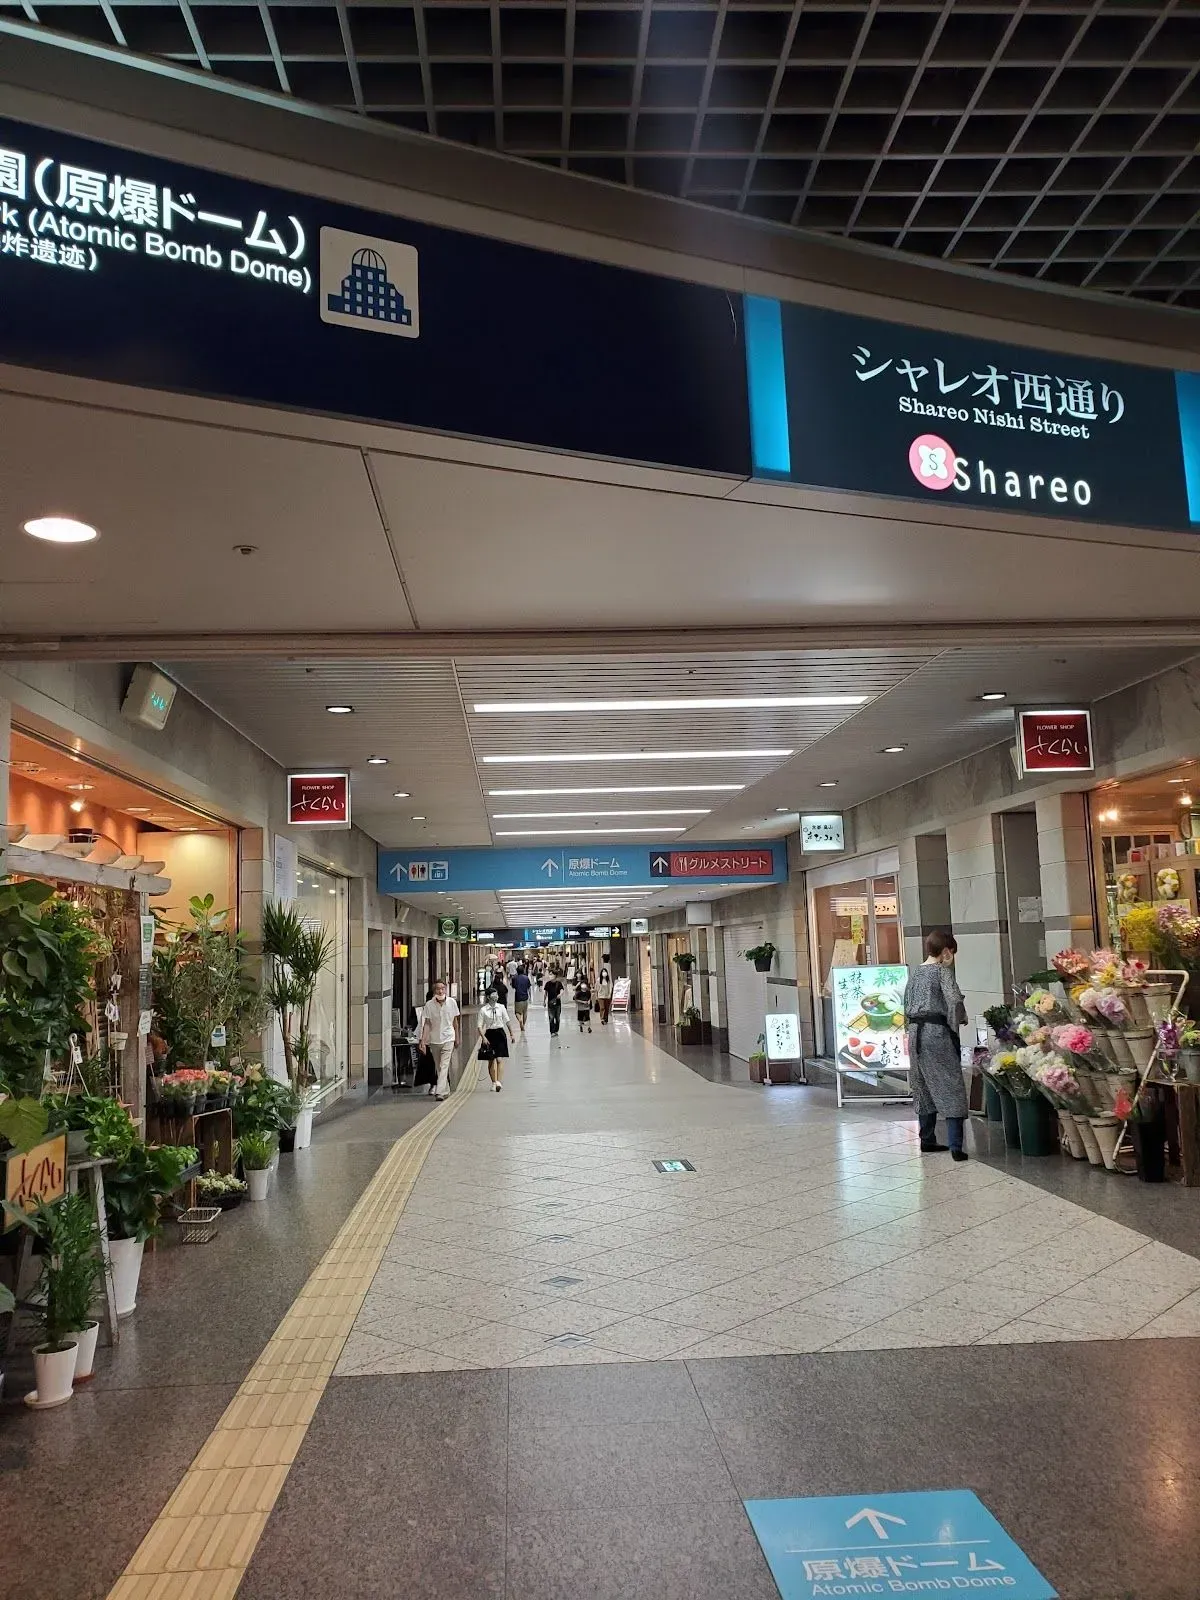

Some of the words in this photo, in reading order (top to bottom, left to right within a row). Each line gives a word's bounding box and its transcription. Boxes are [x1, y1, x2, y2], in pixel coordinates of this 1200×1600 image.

[0, 201, 19, 228] k
[28, 207, 137, 252] (Atomic
[145, 235, 223, 269] Bomb
[230, 250, 312, 294] Dome)
[852, 345, 1125, 424] シャレオ西通り
[899, 396, 969, 422] Shareo
[974, 407, 1025, 431] Nishi
[1030, 416, 1091, 440] Street
[953, 457, 1092, 506] Shareo
[1026, 735, 1088, 756] さくらい
[291, 793, 345, 811] さくらい
[568, 857, 620, 870] 原爆ドーム
[689, 856, 768, 869] グルメストリート
[849, 970, 866, 1000] 抹茶
[801, 1551, 1006, 1581] 原爆ドーム
[811, 1580, 884, 1597] Atomic
[888, 1577, 951, 1593] Bomb
[953, 1574, 1017, 1590] Dome
